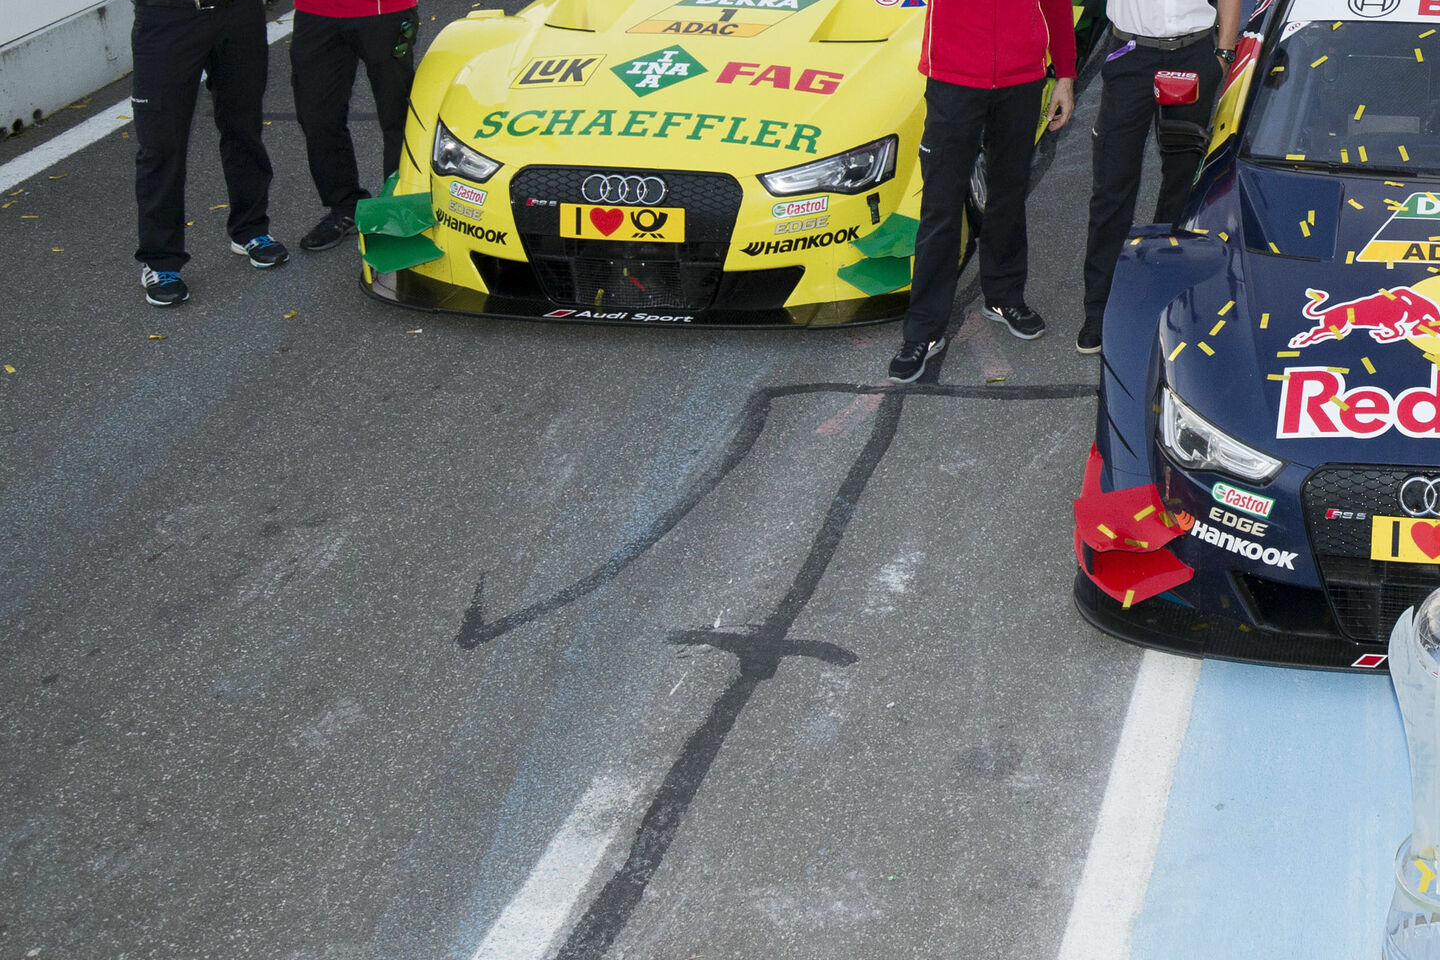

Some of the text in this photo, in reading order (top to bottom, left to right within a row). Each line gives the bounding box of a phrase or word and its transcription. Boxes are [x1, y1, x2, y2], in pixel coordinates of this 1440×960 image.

[717, 8, 733, 22] 1
[662, 21, 739, 36] ADAC
[716, 61, 844, 95] FAG
[1157, 70, 1198, 79] ORIS
[474, 109, 823, 154] SCHAEFFLER
[456, 185, 485, 204] Castrol
[448, 200, 485, 221] EDGE
[786, 199, 826, 215] Castrol
[774, 215, 831, 235] EDGE
[574, 309, 695, 324] Audi Sport
[1225, 488, 1271, 515] Castrol
[1208, 506, 1269, 537] EDGE
